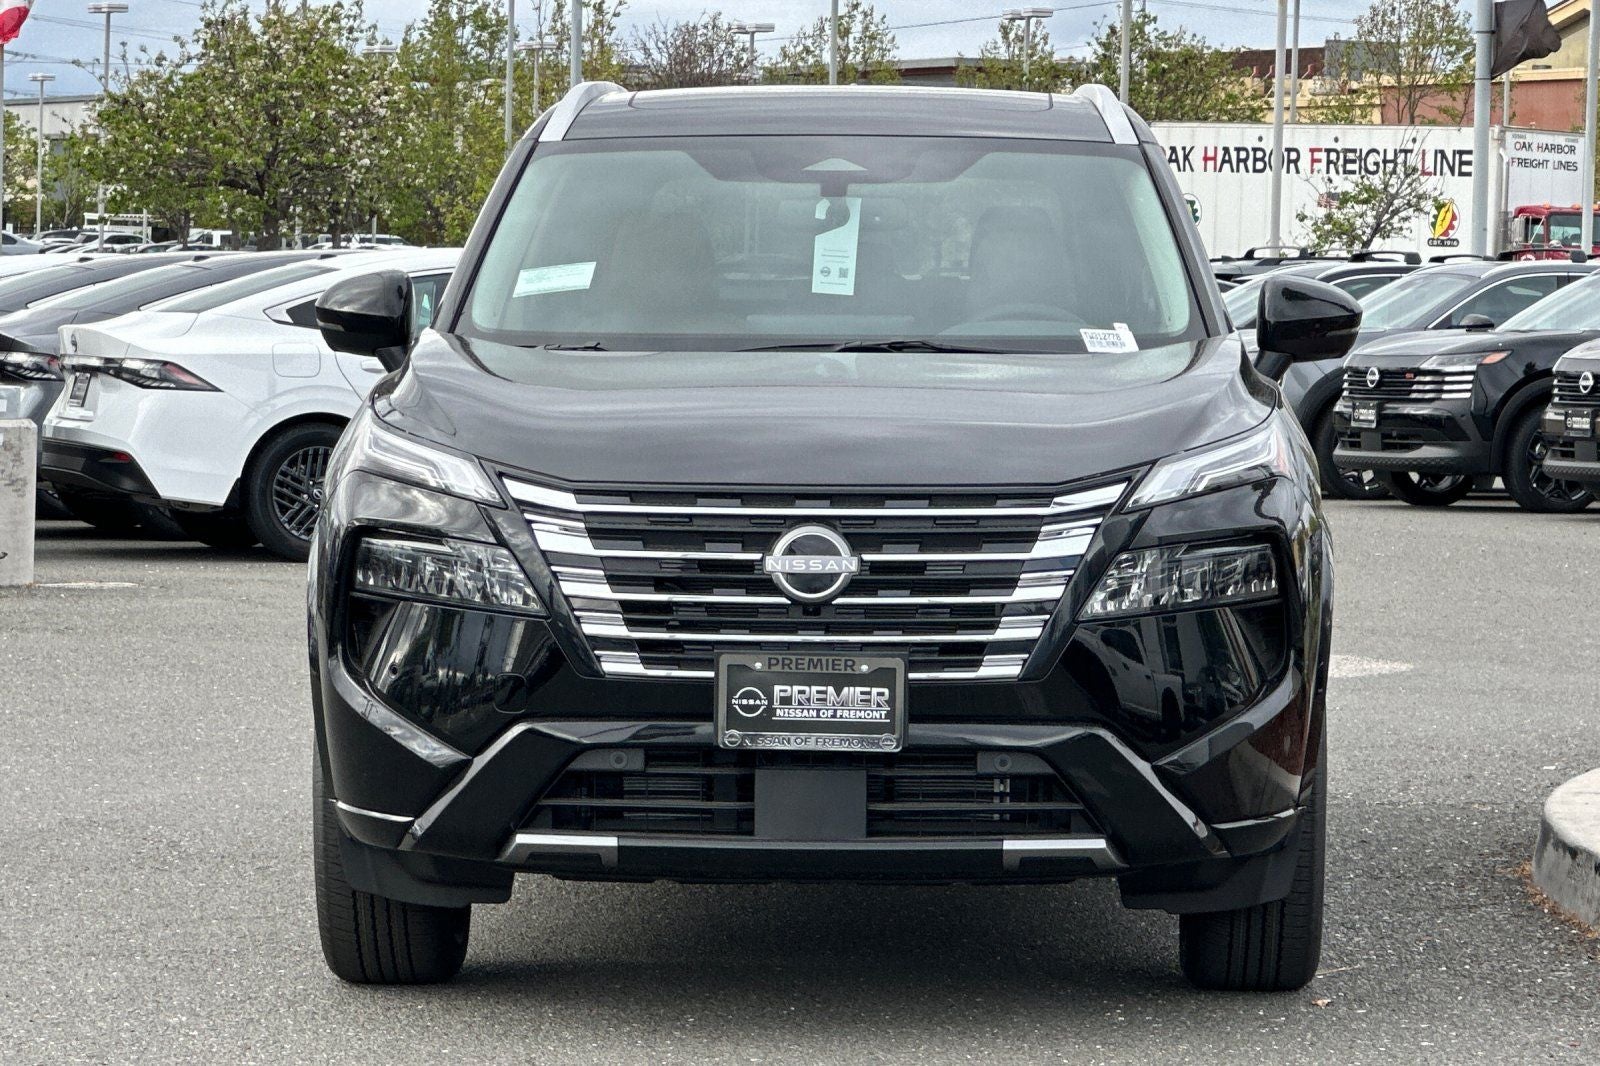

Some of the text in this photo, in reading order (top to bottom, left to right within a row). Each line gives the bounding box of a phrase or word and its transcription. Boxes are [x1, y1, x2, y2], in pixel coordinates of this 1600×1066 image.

[1514, 141, 1577, 155] OAK HARBOR
[1161, 146, 1195, 173] AK
[1309, 148, 1413, 176] FREIGHT
[1511, 157, 1578, 171] FREIGHT LINES
[768, 559, 856, 570] NISSAN
[767, 657, 857, 672] PREMIER
[731, 698, 768, 706] NISSAN
[773, 684, 890, 708] PREMIER
[775, 708, 887, 719] NISSAN OF FREMONT
[743, 735, 791, 747] NSSAN
[794, 736, 813, 747] OF
